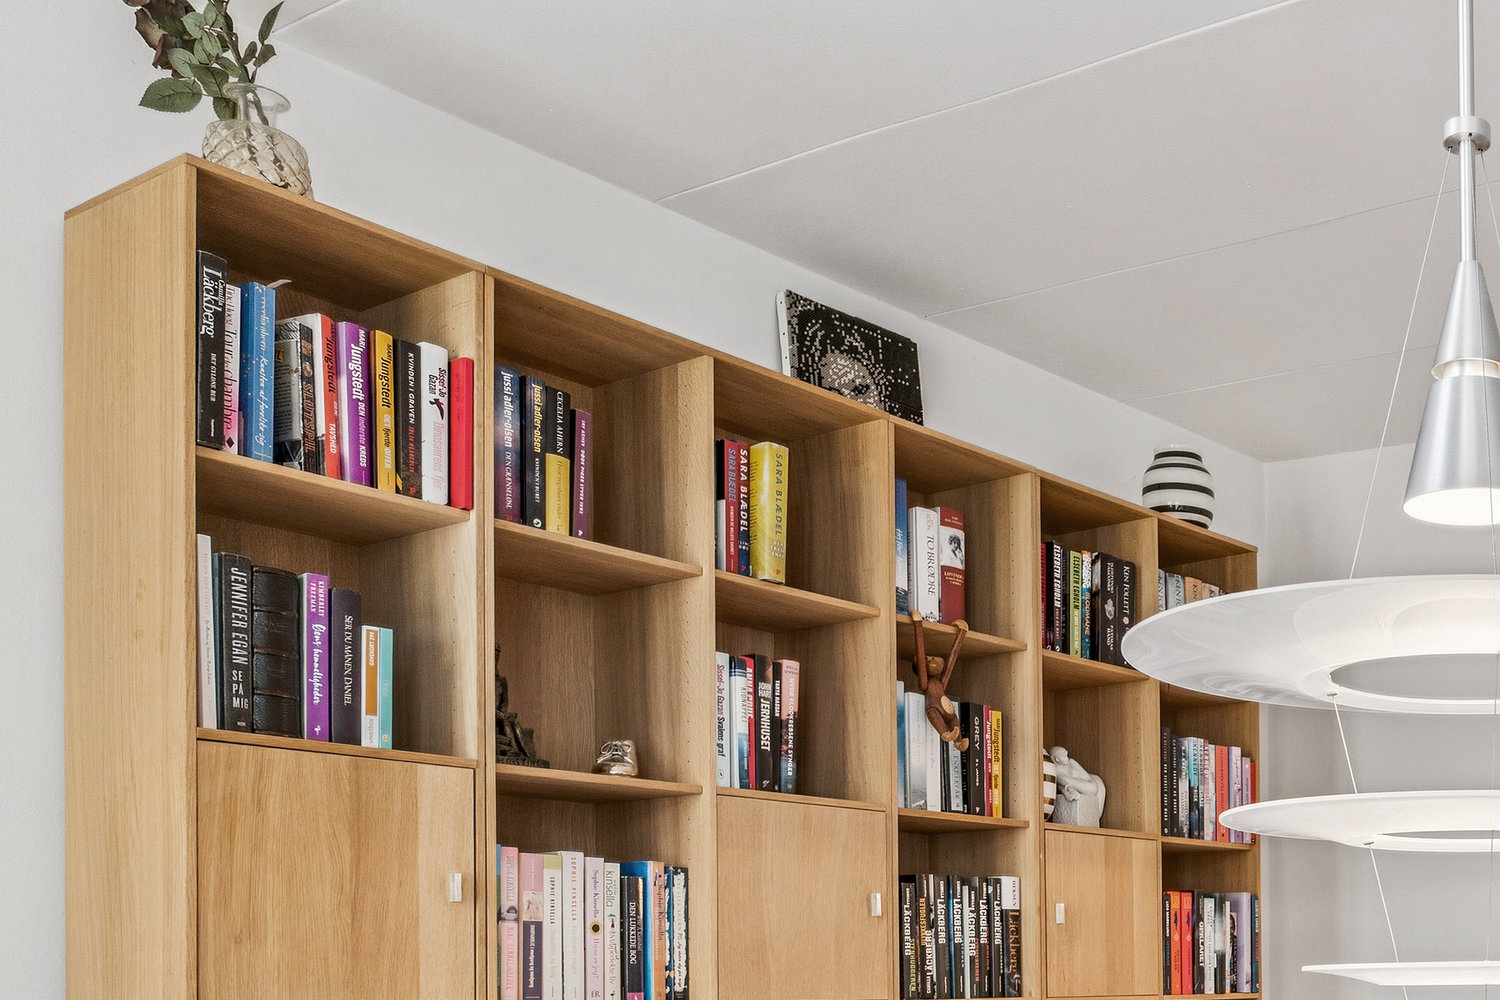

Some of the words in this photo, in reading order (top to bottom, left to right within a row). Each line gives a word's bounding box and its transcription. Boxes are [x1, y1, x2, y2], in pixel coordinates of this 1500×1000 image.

[200, 265, 222, 336] Läckberg
[348, 344, 363, 400] Jungstedt
[428, 374, 438, 394] Gazan
[438, 368, 446, 398] Sissel-Jo
[501, 372, 513, 394] jussi
[329, 423, 338, 454] TAVSHED
[504, 396, 513, 448] adler-olsen
[504, 452, 512, 466] DEN
[740, 448, 748, 480] SARA
[927, 535, 934, 550] TO
[927, 552, 936, 596] BRØDRE
[231, 567, 248, 628] JENNIFER
[1054, 578, 1062, 608] EGHOLM
[232, 632, 248, 664] EGAN
[232, 670, 243, 682] SE
[232, 696, 249, 710] MIG
[760, 698, 770, 751] JERNHUSET
[606, 870, 615, 907] kinsella
[938, 899, 946, 944] LÄCKBERG
[954, 898, 962, 944] LÄCKBERG
[980, 900, 988, 944] LÄCKBERG
[1008, 912, 1020, 974] Läckberg
